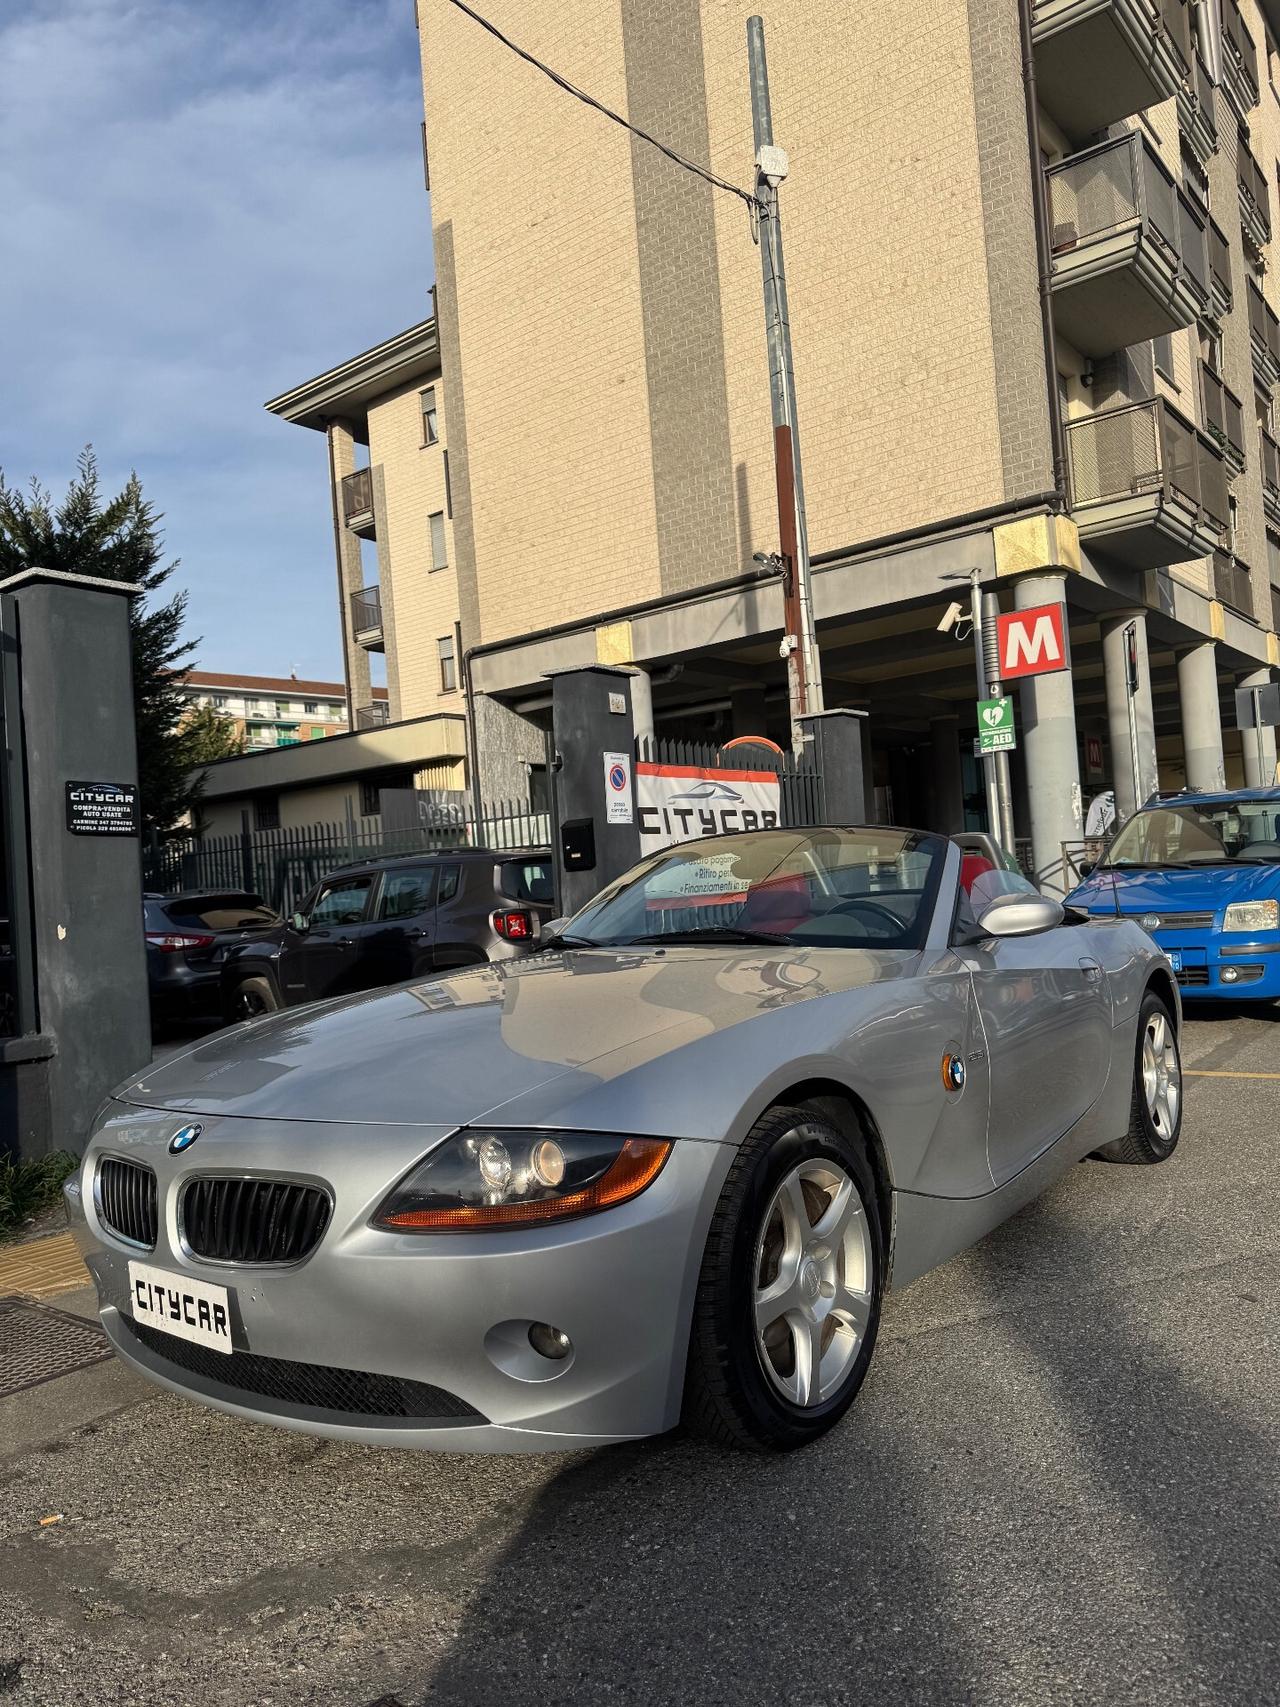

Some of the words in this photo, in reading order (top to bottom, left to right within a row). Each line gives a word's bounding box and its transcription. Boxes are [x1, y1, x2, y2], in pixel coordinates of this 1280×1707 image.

[1005, 615, 1060, 669] M
[992, 733, 1012, 745] AED
[70, 792, 134, 803] CITYCAR
[637, 807, 777, 834] CITYCAR
[699, 868, 718, 879] Ritiro
[135, 1279, 228, 1337] CITYCAR
